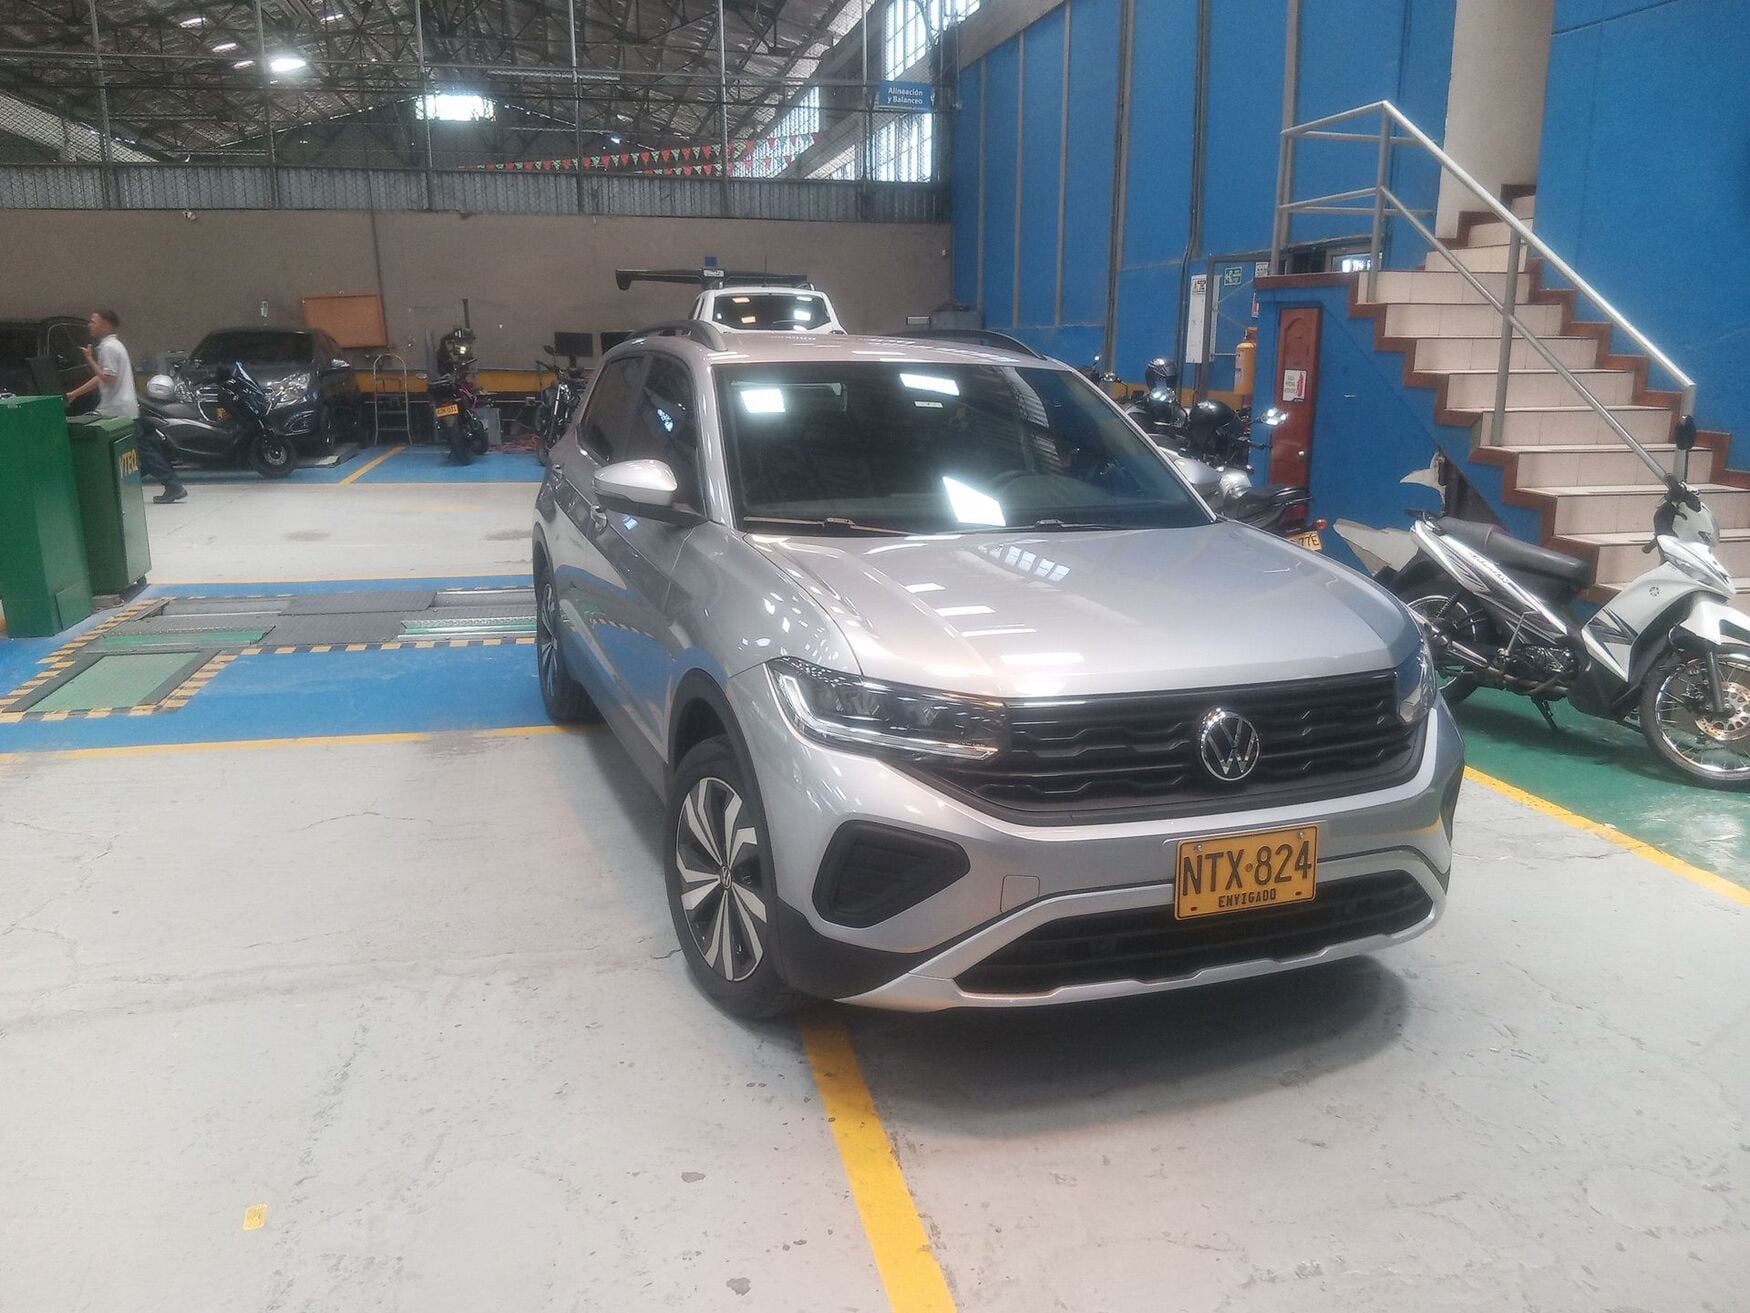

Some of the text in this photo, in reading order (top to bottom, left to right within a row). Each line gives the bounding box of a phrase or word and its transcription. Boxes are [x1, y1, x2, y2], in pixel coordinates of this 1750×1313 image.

[888, 87, 923, 96] Alineación
[893, 95, 923, 105] Balanceo
[1218, 888, 1277, 908] ENVIGADO
